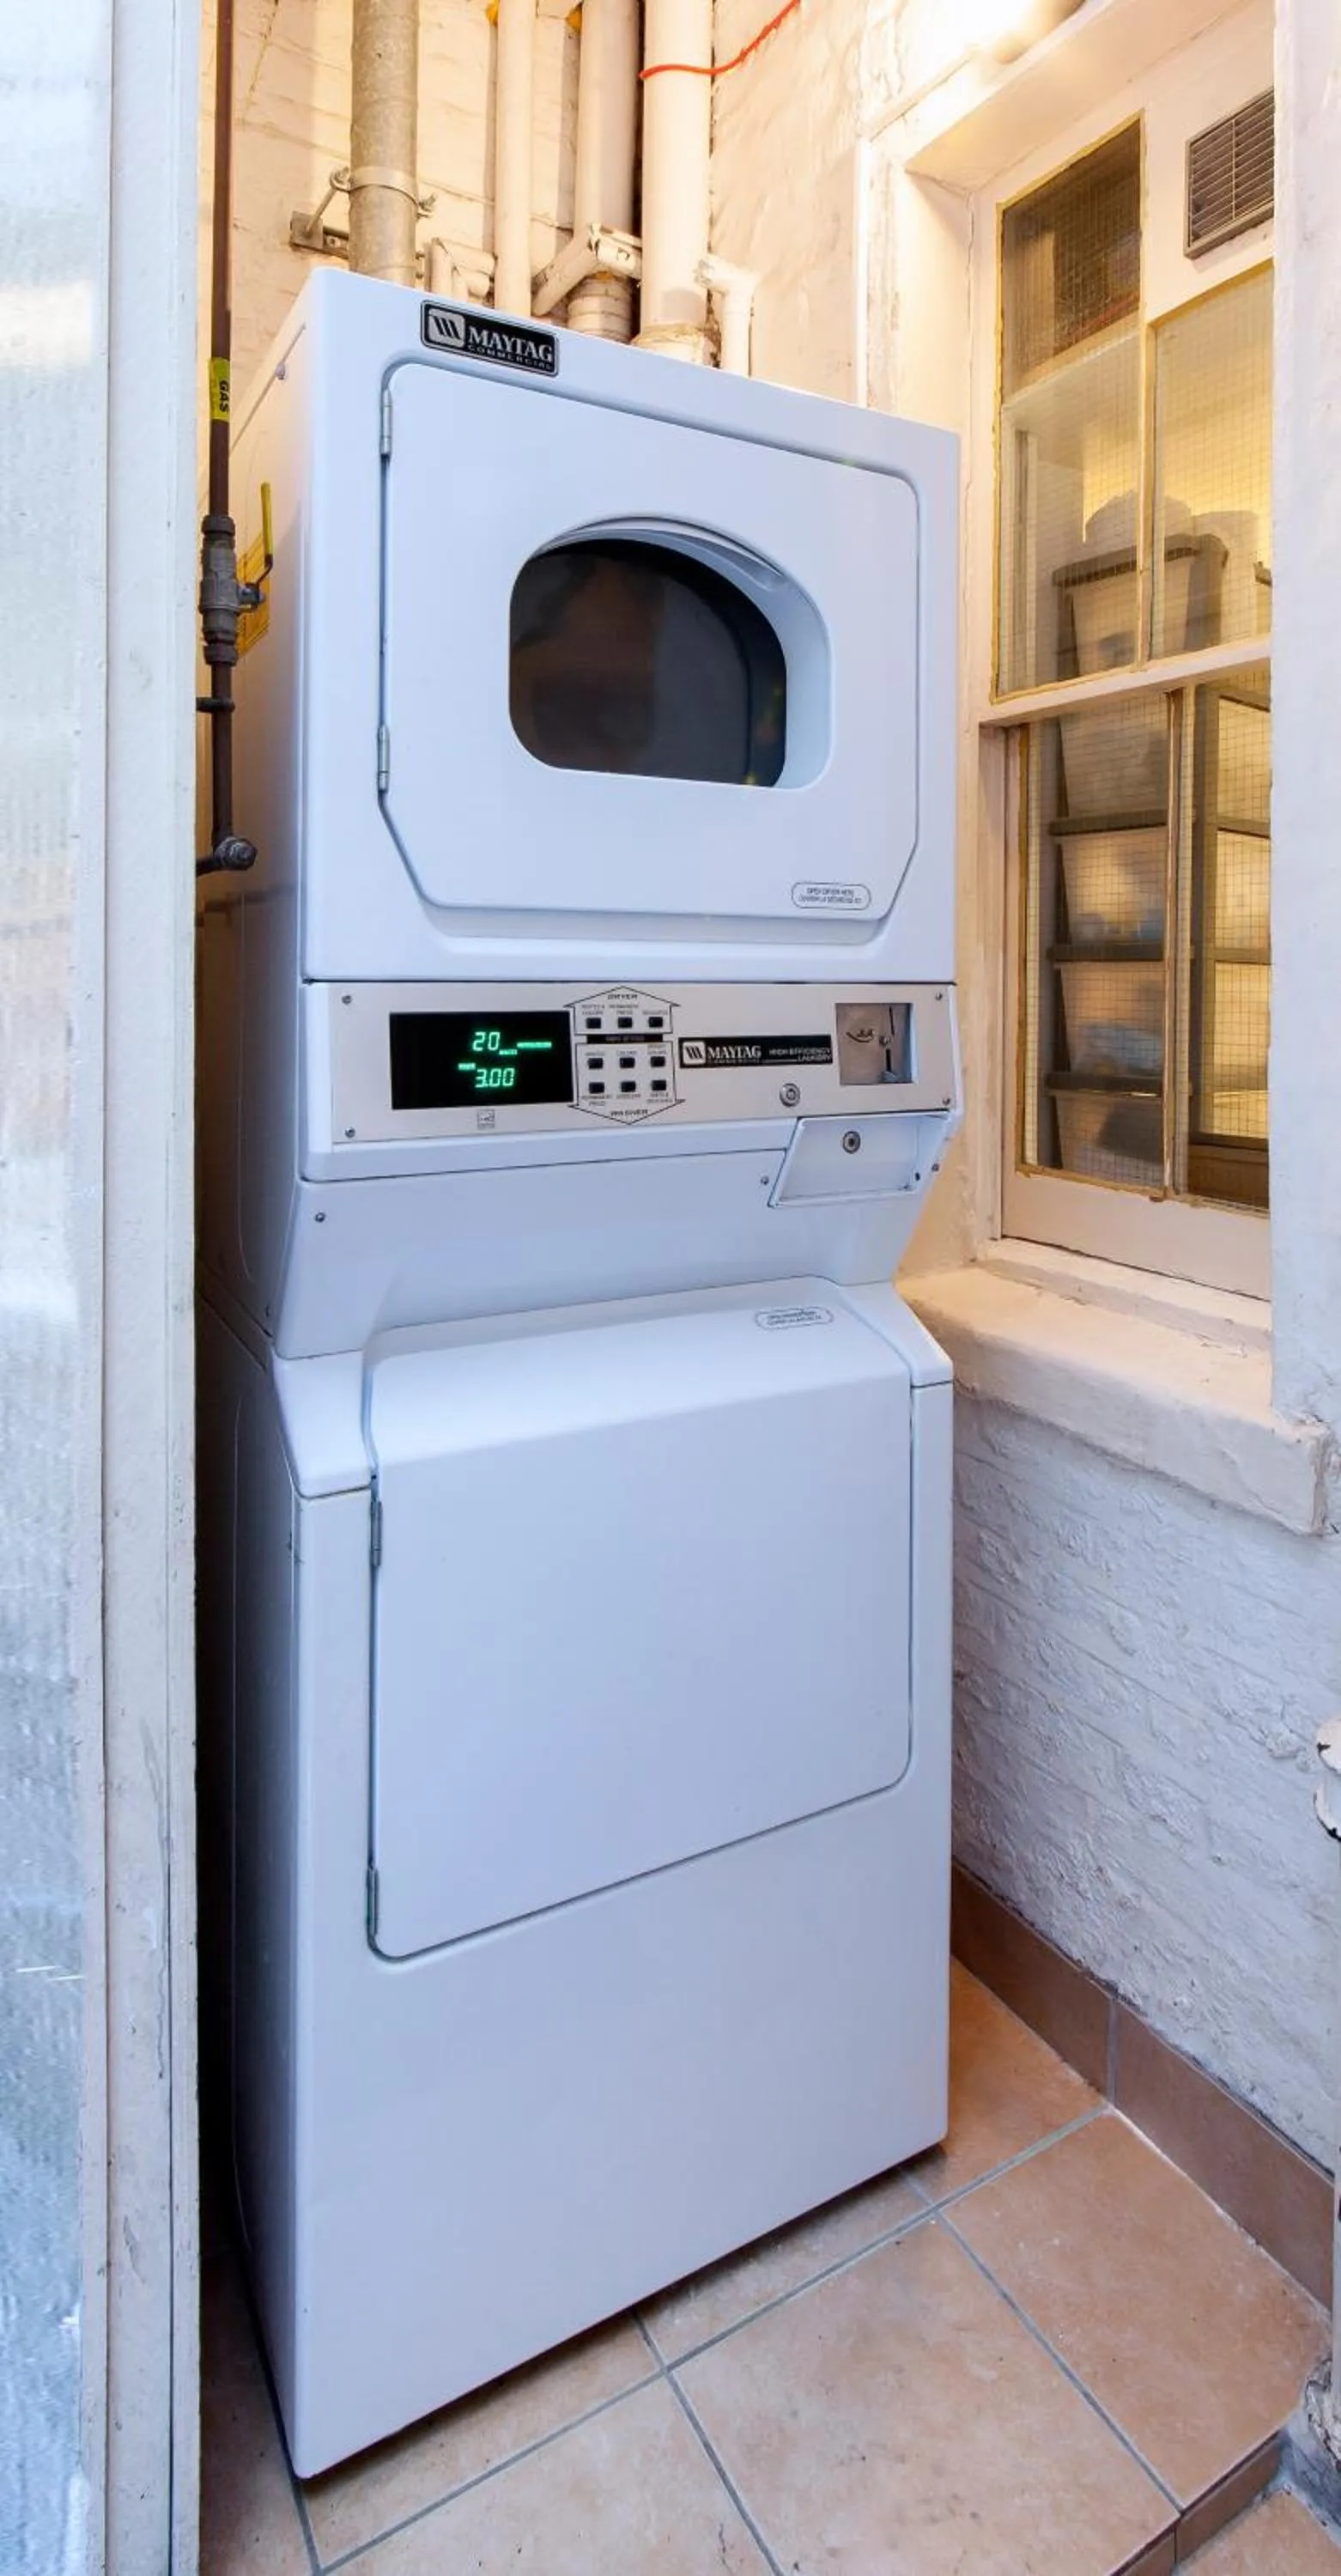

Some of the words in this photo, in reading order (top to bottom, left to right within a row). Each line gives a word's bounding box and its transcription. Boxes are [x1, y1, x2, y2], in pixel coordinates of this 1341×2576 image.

[468, 326, 552, 362] MAYTAG
[468, 345, 551, 370] COMMERCIAL
[219, 380, 229, 413] GAS
[473, 1031, 501, 1051] 20
[707, 1045, 762, 1059] MAYTAG
[475, 1068, 515, 1088] 3.00
